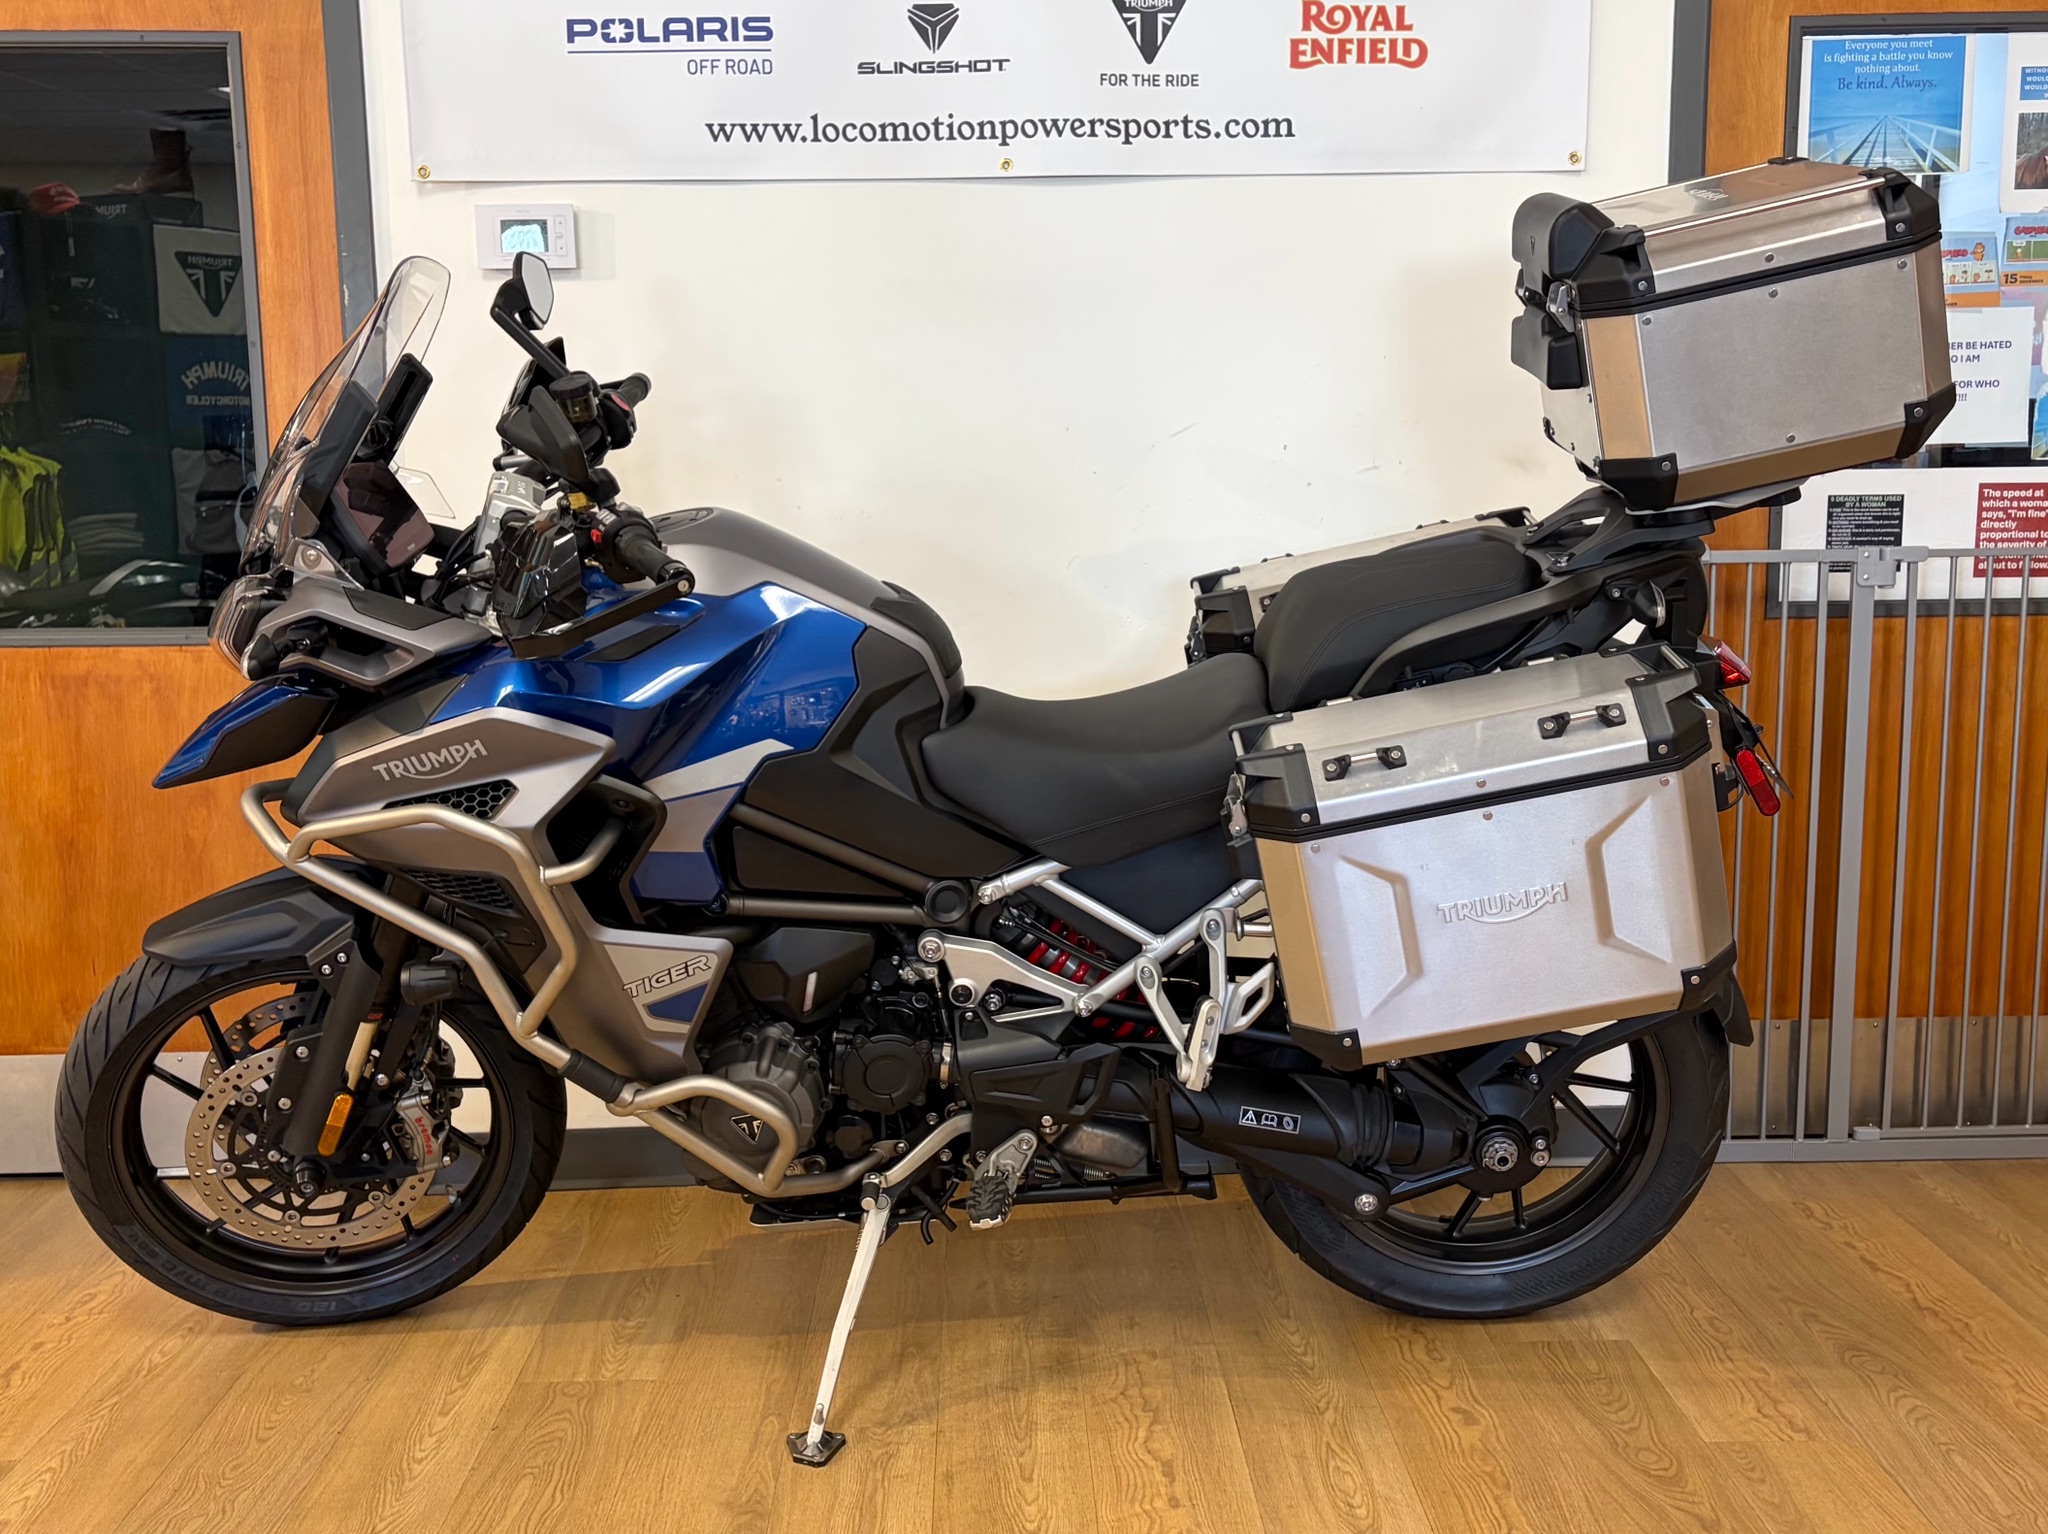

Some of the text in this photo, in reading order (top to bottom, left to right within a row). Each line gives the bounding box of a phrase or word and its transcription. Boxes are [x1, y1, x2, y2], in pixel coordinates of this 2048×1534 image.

[1124, 0, 1174, 9] TRIUMPH
[1300, 2, 1414, 34] ROYAL
[566, 16, 774, 44] POLARIS
[1845, 40, 1934, 51] Everyone you meet
[1289, 36, 1429, 70] ENFIELD
[1824, 53, 1832, 62] is
[1833, 53, 1870, 64] fighting
[1879, 51, 1906, 61] battle
[1907, 52, 1925, 62] you
[1927, 51, 1953, 59] know
[686, 58, 774, 75] OFF ROAD
[857, 59, 1011, 75] SLINGSHOT
[1854, 63, 1921, 75] nothing about.
[1100, 73, 1199, 87] FOR THE RIDE
[1838, 74, 1937, 92] Be kind. Always.
[705, 113, 1296, 146] www.locomotionpowersports.com
[2003, 273, 2018, 284] 15
[1950, 340, 2013, 350] ER BE HATED
[1965, 354, 1980, 363] AM
[1954, 380, 2000, 389] FOR WHO
[1982, 488, 2044, 499] The speed at
[1982, 499, 2010, 508] which
[1981, 510, 2006, 519] says,
[1980, 520, 2017, 530] directly
[1980, 530, 2039, 540] proportional
[1997, 540, 2035, 548] severity
[2036, 540, 2047, 548] of
[372, 739, 489, 781] TRIUMPH
[1437, 881, 1568, 924] TRIUMPH
[622, 955, 711, 998] TIGER
[414, 1116, 434, 1156] brembo
